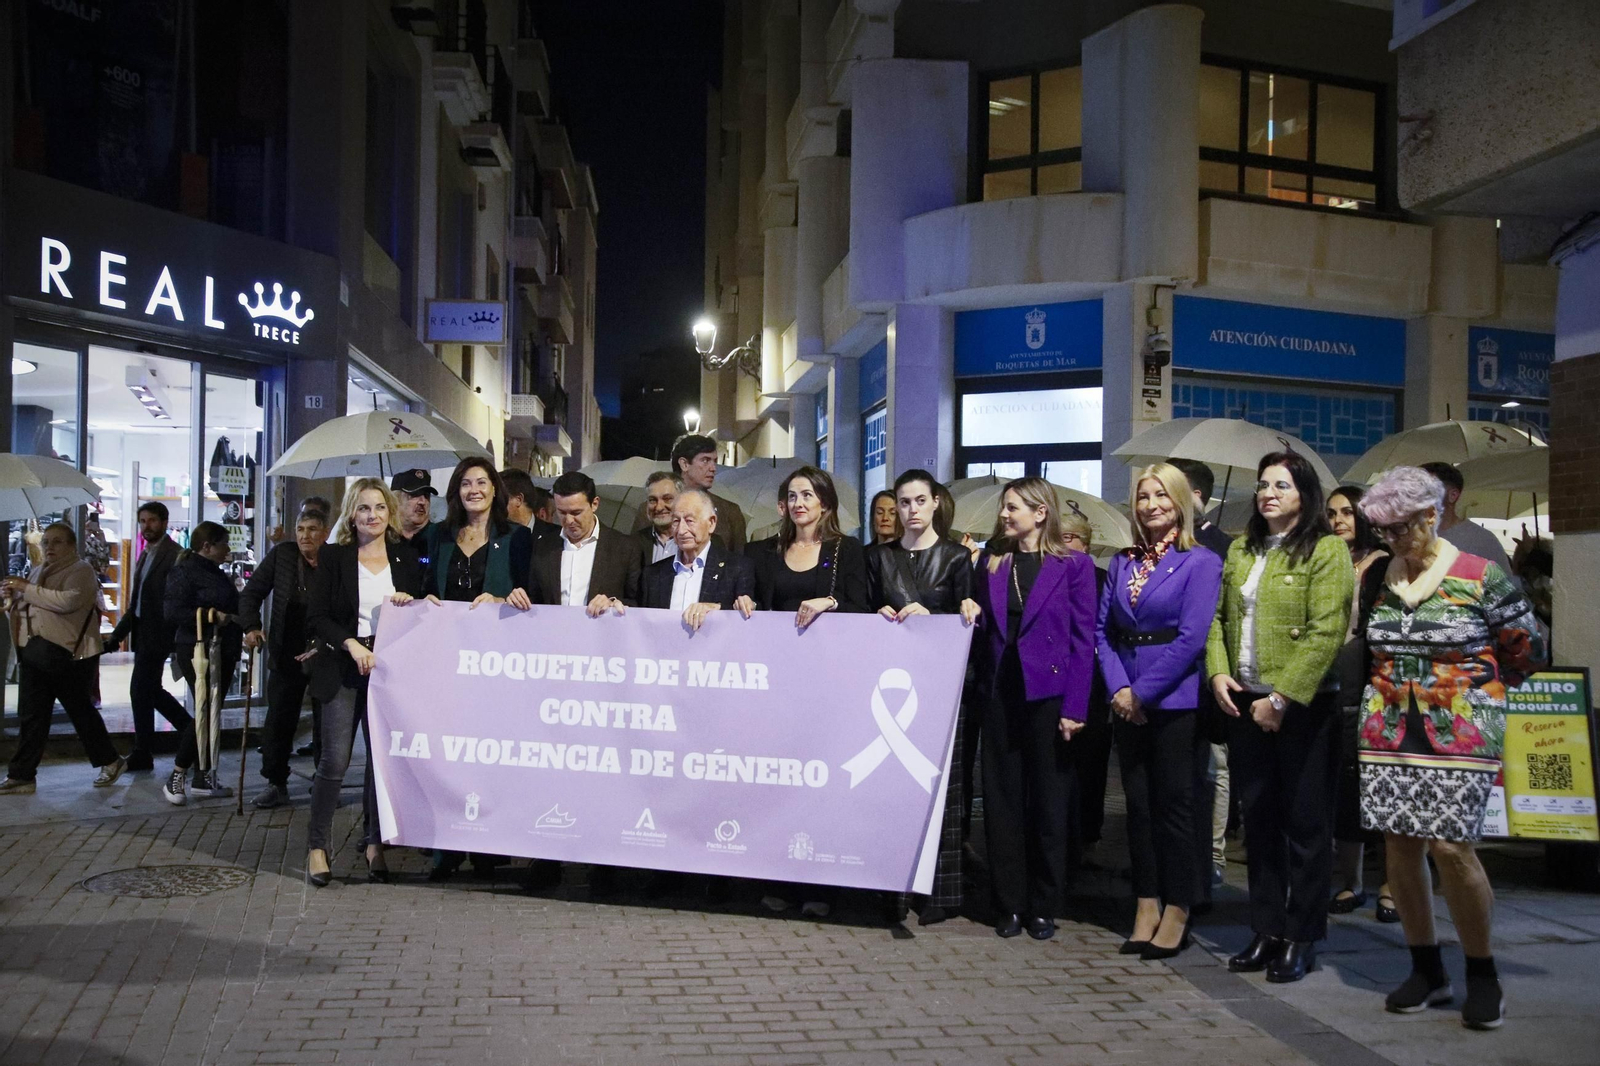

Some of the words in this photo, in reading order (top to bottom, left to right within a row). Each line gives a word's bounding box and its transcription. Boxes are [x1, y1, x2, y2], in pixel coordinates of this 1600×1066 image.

[41, 236, 225, 330] REAL
[430, 316, 467, 327] REAL
[253, 322, 300, 345] TRECE
[1209, 329, 1277, 348] ATENCIÓN
[1280, 336, 1357, 356] CIUDADANA
[308, 396, 321, 408] 18
[1031, 400, 1101, 412] CIUDADANA
[927, 458, 934, 466] 12
[456, 649, 627, 684] ROQUETAS
[633, 657, 680, 686] DE
[686, 660, 769, 690] MAR
[1507, 693, 1553, 702] TOURS
[1508, 702, 1578, 712] ROQUETAS
[539, 697, 677, 732] CONTRA
[1522, 720, 1566, 734] Reserva
[1534, 737, 1564, 748] ahora
[389, 730, 431, 759] LA
[442, 735, 621, 774] VIOLENCIA
[629, 748, 675, 778] DE
[682, 748, 829, 788] GÉNERO
